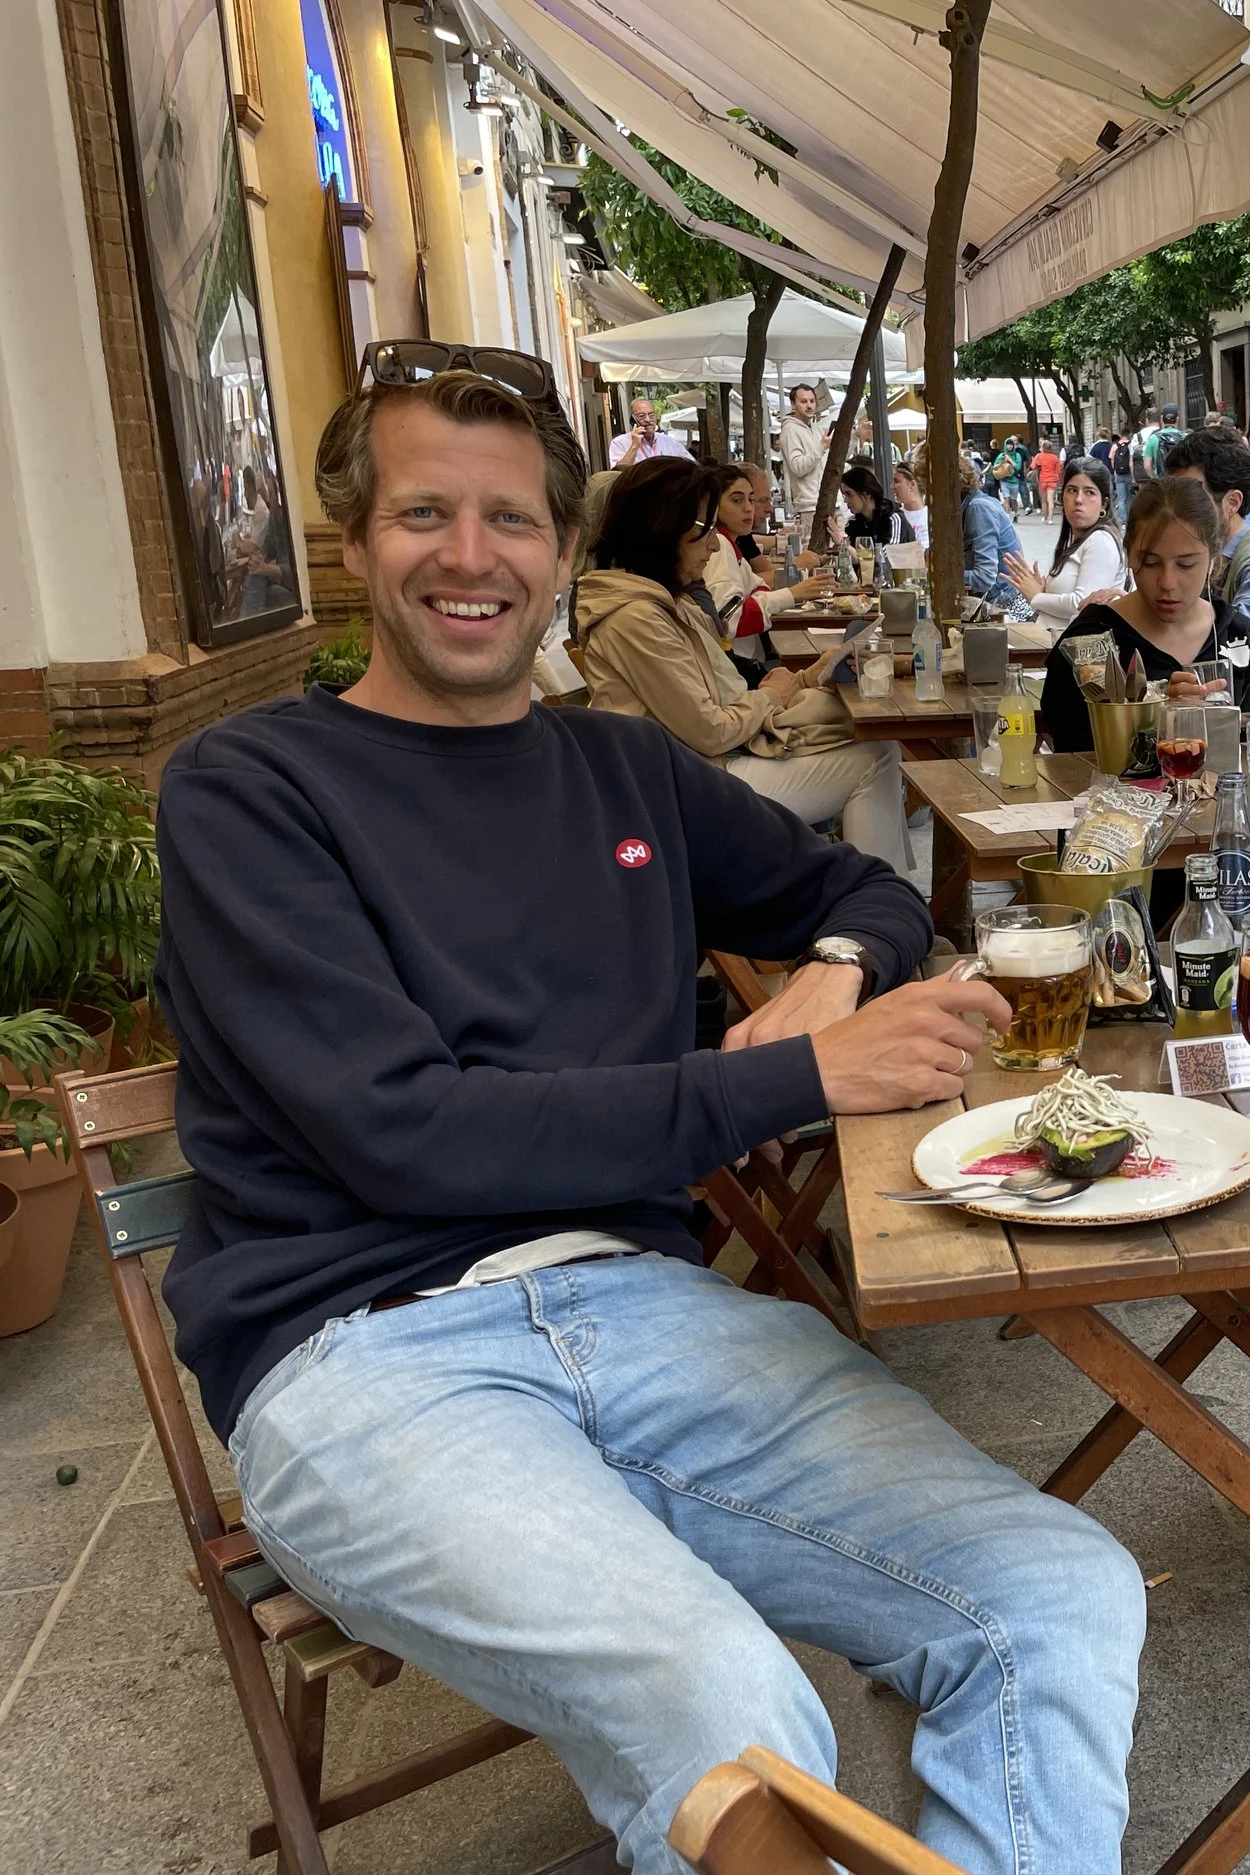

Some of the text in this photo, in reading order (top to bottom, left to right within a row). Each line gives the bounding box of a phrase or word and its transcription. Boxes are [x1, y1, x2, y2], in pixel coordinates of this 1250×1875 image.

[1195, 886, 1217, 895] Minute
[1199, 892, 1216, 900] Maid
[1182, 961, 1211, 970] Minute
[1185, 969, 1209, 978] Maid
